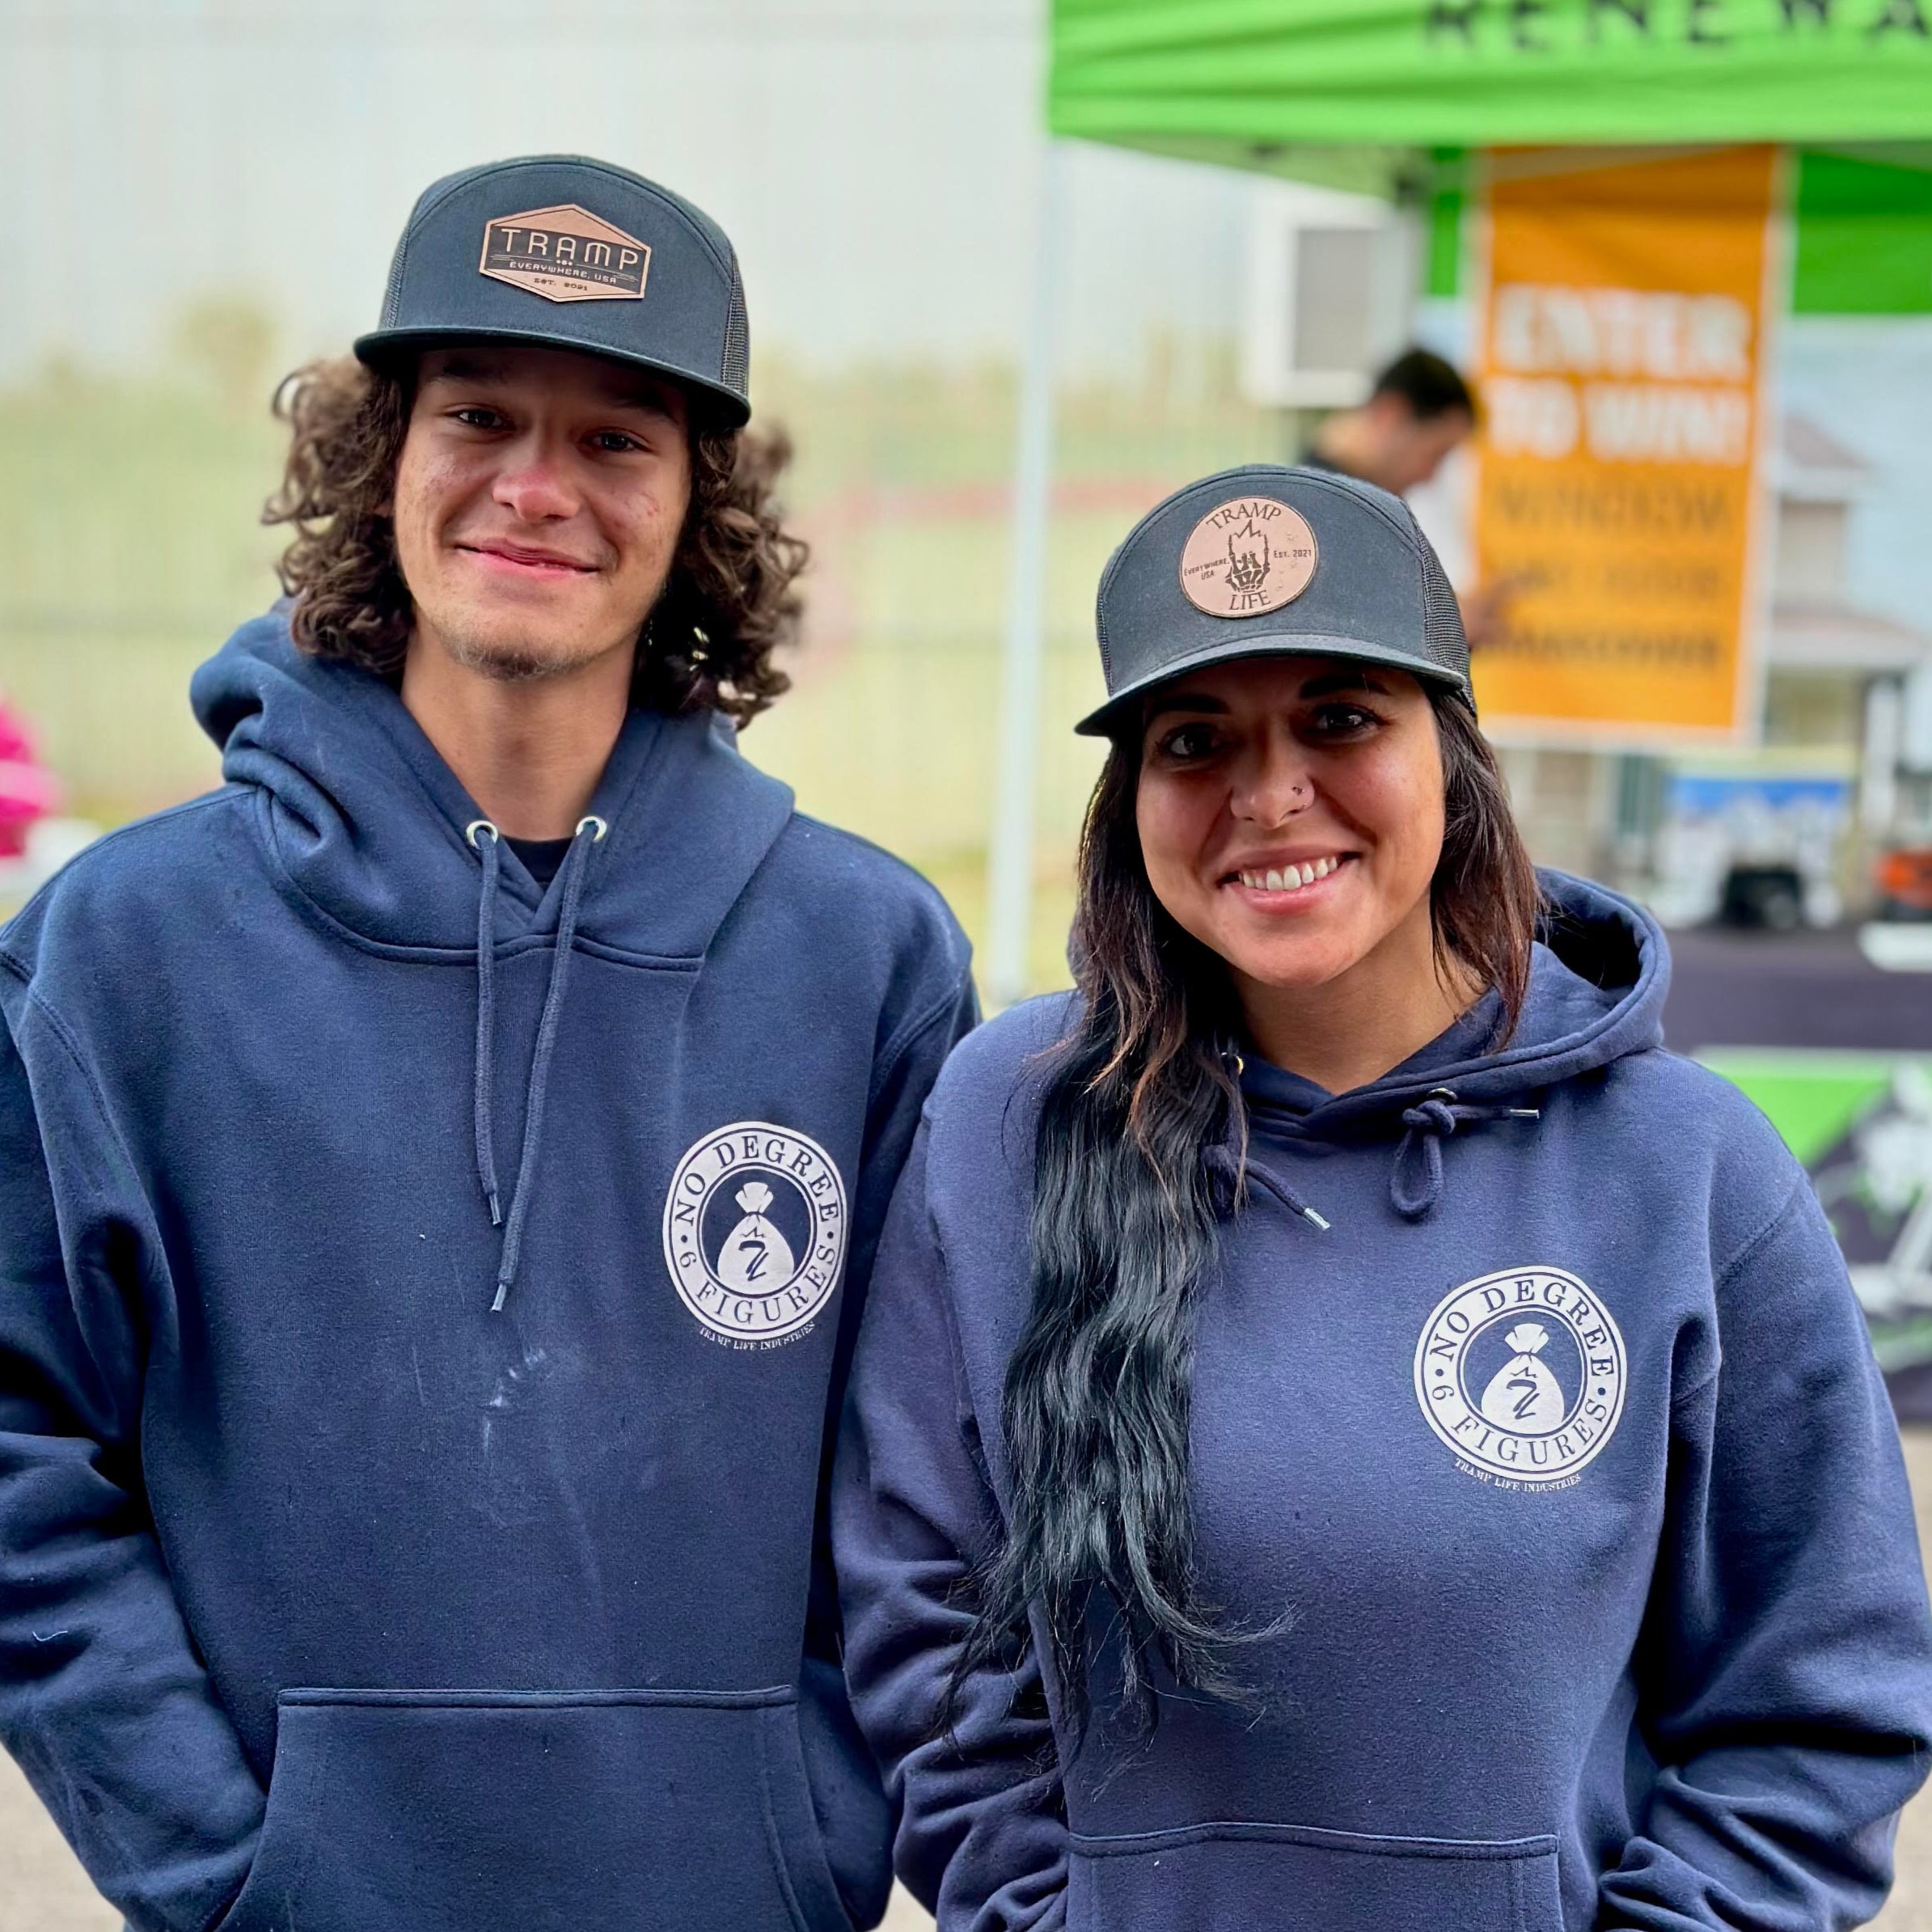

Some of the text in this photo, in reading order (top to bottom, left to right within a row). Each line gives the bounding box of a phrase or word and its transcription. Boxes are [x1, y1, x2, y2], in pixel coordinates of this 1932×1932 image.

[501, 228, 638, 270] TRAMP
[509, 261, 617, 284] EVERYWHERE, USA
[564, 282, 588, 291] 2021
[1492, 282, 1753, 380] ENTER
[1487, 375, 1579, 459] TO
[1206, 502, 1281, 529] TRAMP
[1292, 549, 1312, 558] 2021
[1200, 570, 1215, 581] USA
[1229, 590, 1271, 611] LIFE
[674, 1135, 839, 1227] NO DEGREE
[695, 1245, 835, 1325] FIGURES
[700, 1326, 731, 1346] TRAMP
[733, 1340, 757, 1351] LIFE
[1429, 1279, 1615, 1376] NO DEGREE
[1451, 1399, 1608, 1465] FIGURES
[1454, 1457, 1581, 1493] TRAMP LIFE INDUSTRIES
